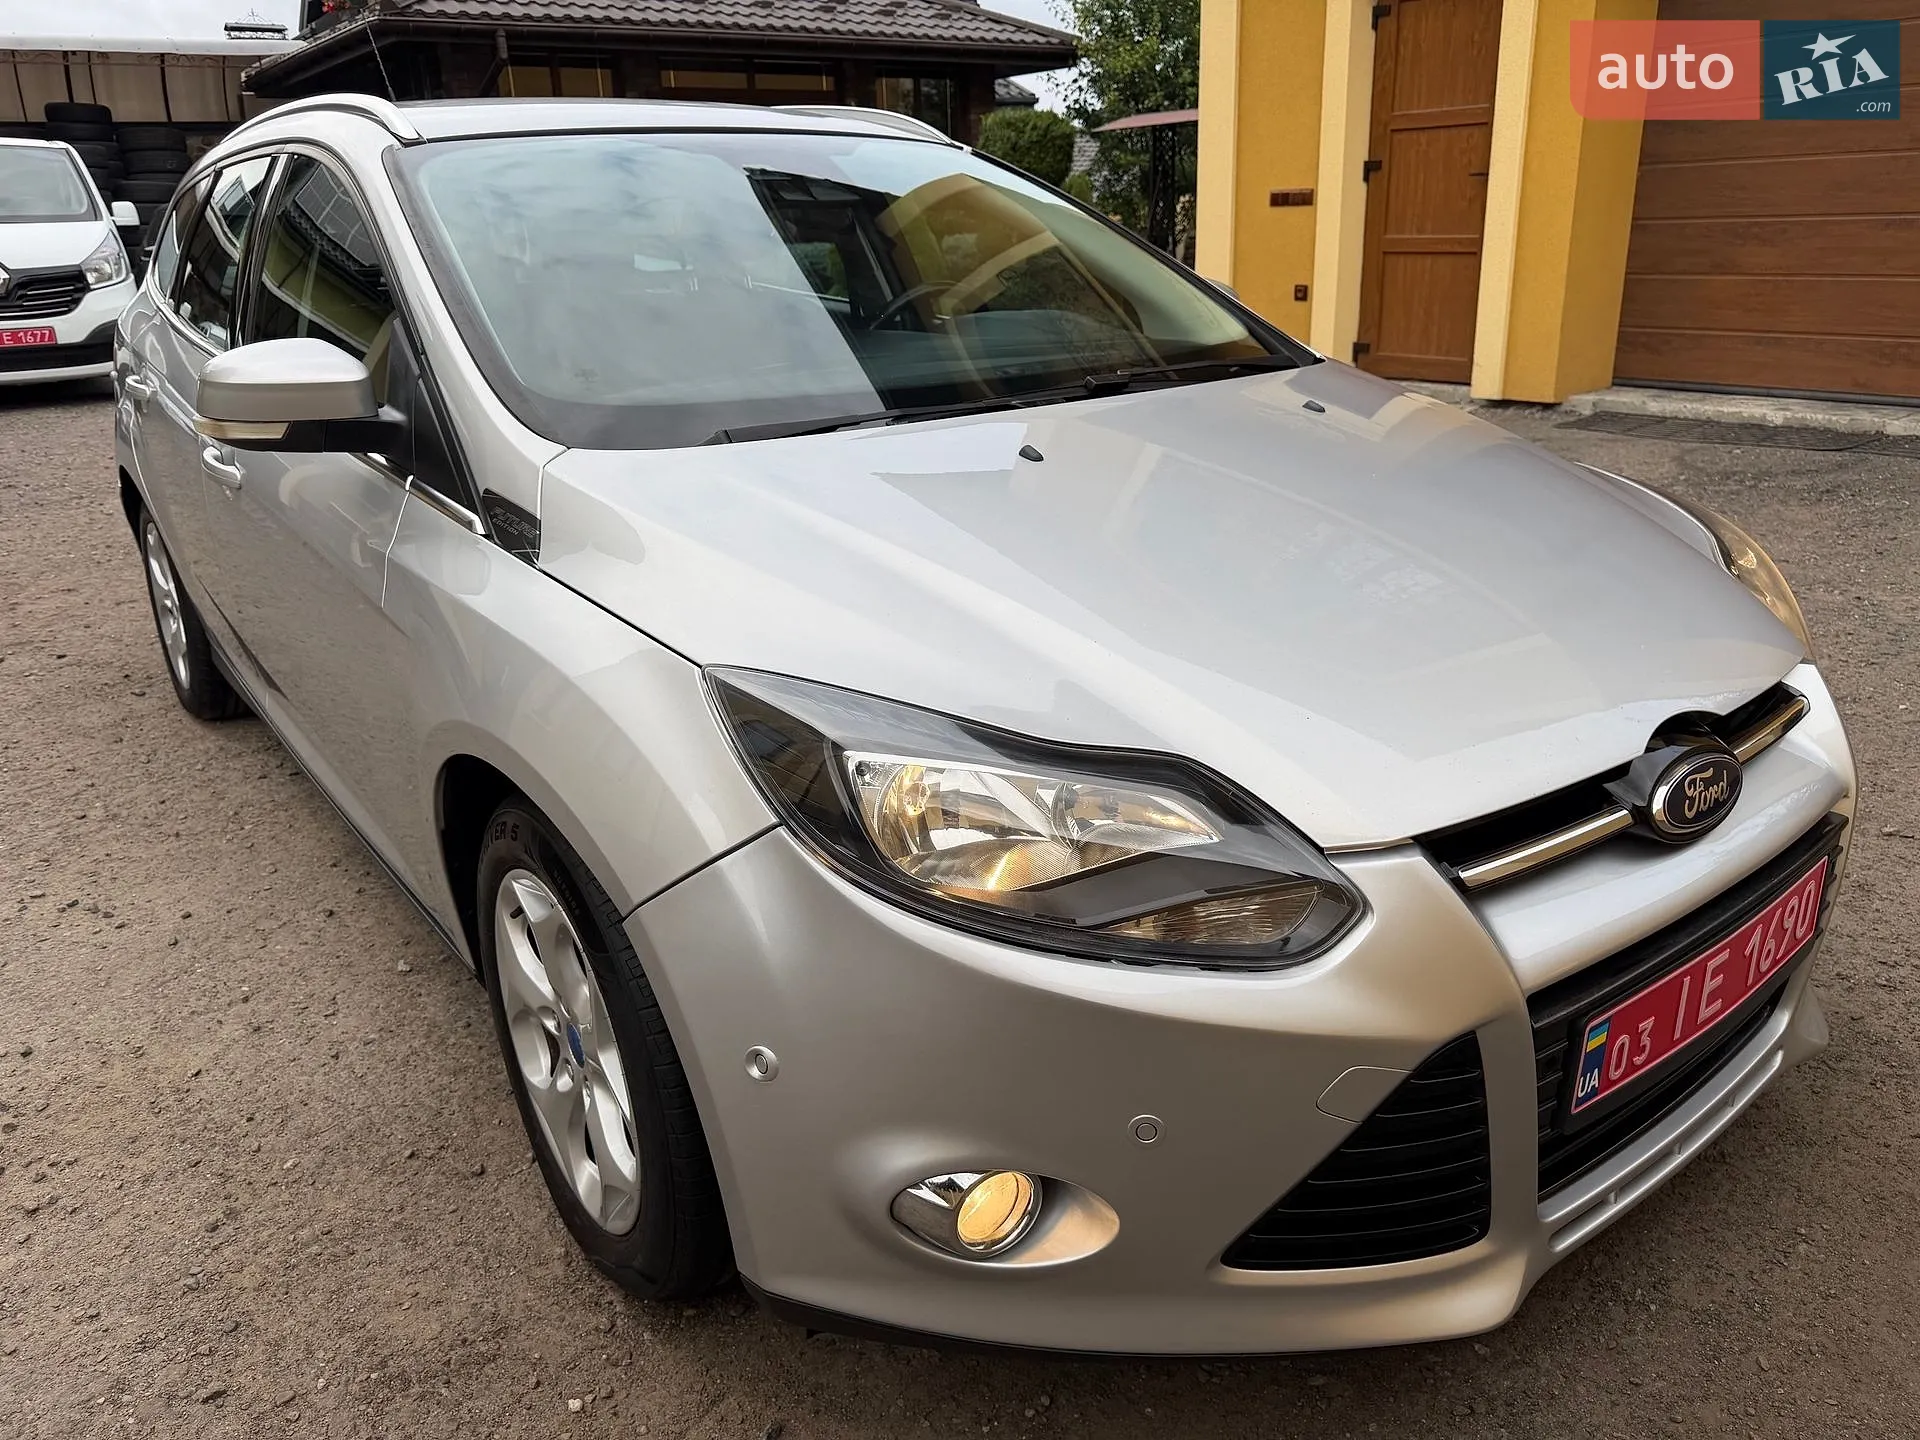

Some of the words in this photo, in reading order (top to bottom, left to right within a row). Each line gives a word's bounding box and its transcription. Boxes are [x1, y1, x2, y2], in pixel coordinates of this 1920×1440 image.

[17, 330, 50, 343] 1677
[1684, 767, 1730, 819] Ford
[1608, 1015, 1656, 1081] 03
[1673, 948, 1730, 1041] IE
[1744, 879, 1816, 988] 1690
[1577, 1067, 1600, 1098] UA
